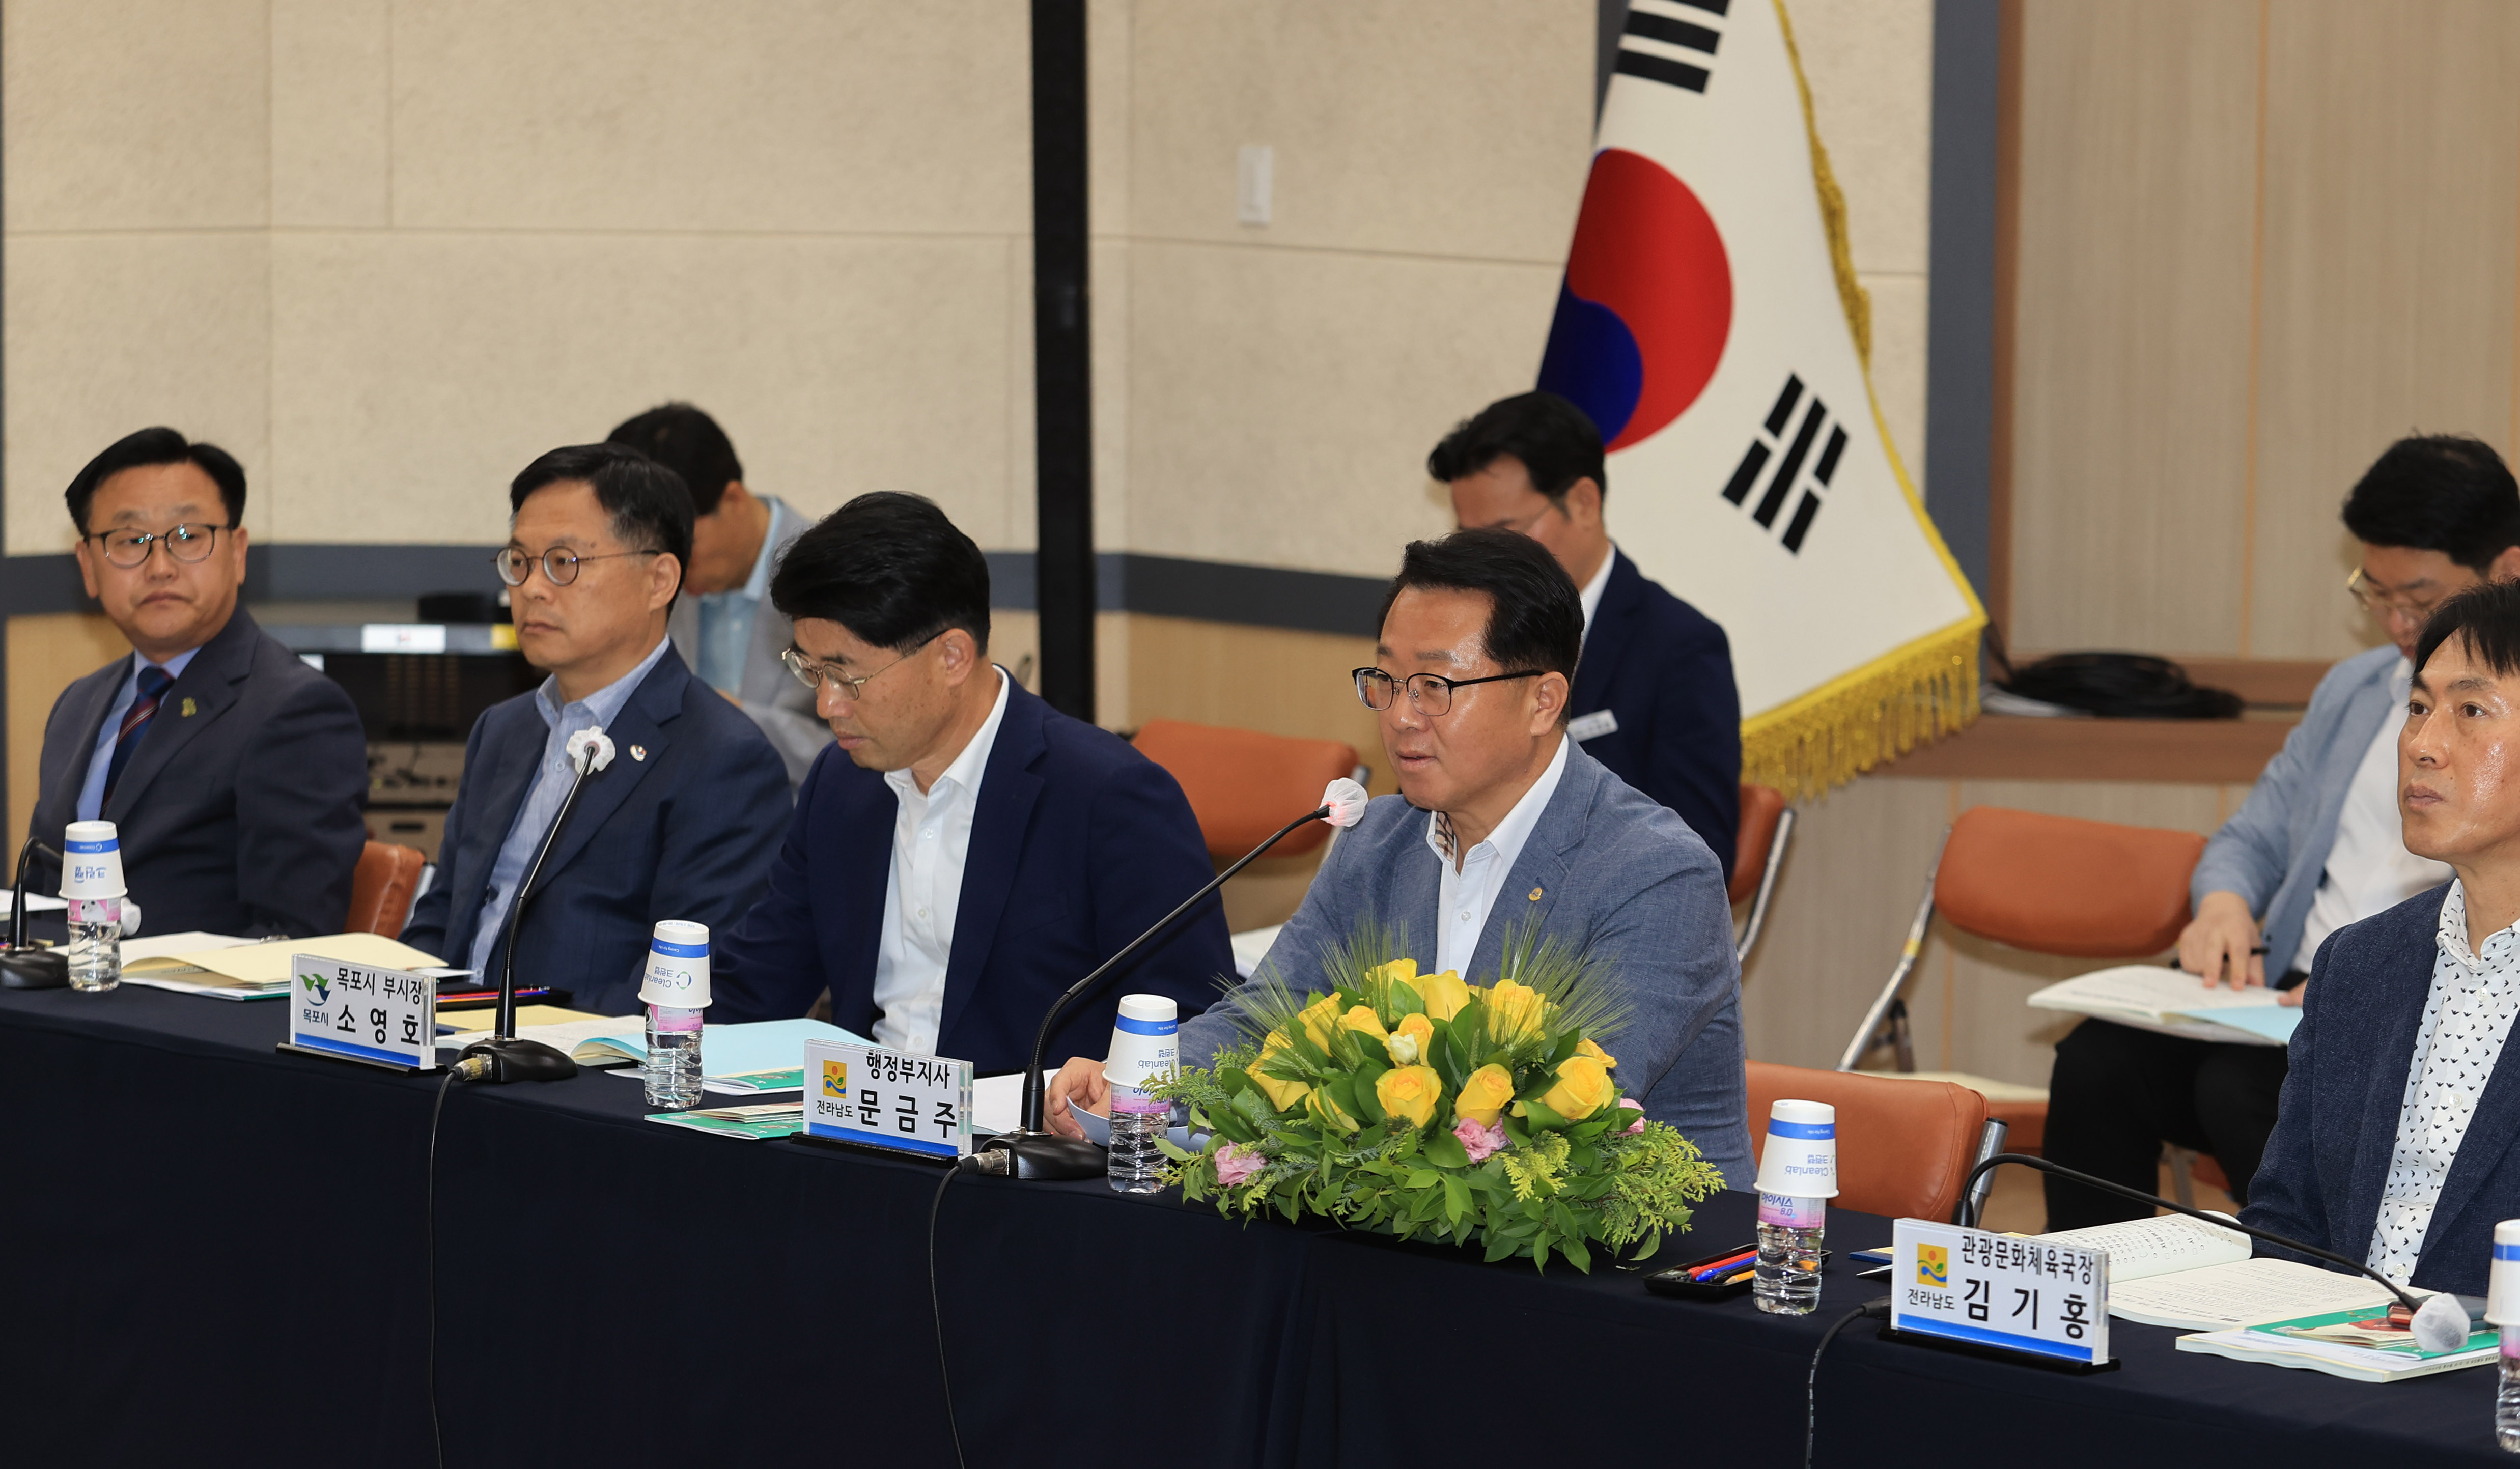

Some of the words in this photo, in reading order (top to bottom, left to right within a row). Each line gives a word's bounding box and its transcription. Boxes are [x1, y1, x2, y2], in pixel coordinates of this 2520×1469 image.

[654, 966, 674, 978] 크린랩
[337, 967, 376, 996] 목포시
[383, 976, 422, 1005] 부시장
[303, 1008, 329, 1027] 목포시
[337, 1004, 356, 1033] 소
[370, 1008, 387, 1044] 영
[401, 1014, 420, 1046] 호
[1158, 1048, 1175, 1058] 크린랩
[866, 1051, 950, 1089] 행정부지사
[817, 1099, 854, 1118] 전라남도
[858, 1089, 881, 1127] 문
[895, 1095, 919, 1134] 금
[933, 1101, 957, 1139] 주
[1807, 1154, 1829, 1164] 크린랩
[1786, 1166, 1829, 1177] Cleanlab
[1780, 1208, 1793, 1216] 8.0
[1962, 1235, 2094, 1285] 관광문화체육국장
[1907, 1288, 1955, 1310] 전라남도
[1964, 1279, 1990, 1322] 김
[2012, 1288, 2038, 1331] 기
[2060, 1294, 2090, 1339] 홍
